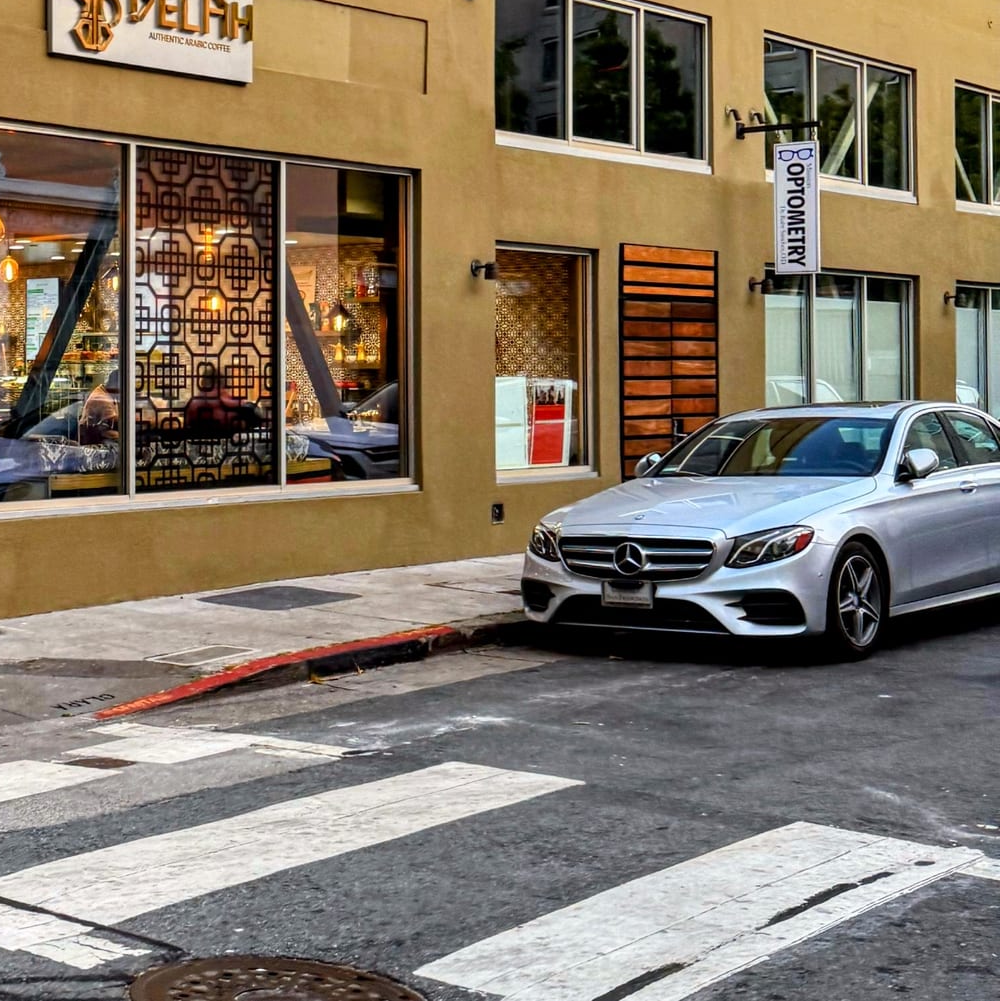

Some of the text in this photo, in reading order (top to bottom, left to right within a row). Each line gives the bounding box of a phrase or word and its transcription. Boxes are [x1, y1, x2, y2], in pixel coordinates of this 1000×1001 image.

[148, 32, 231, 53] AUTHENTIC ARABIC COFFEE
[787, 162, 806, 267] OPTOMETRY
